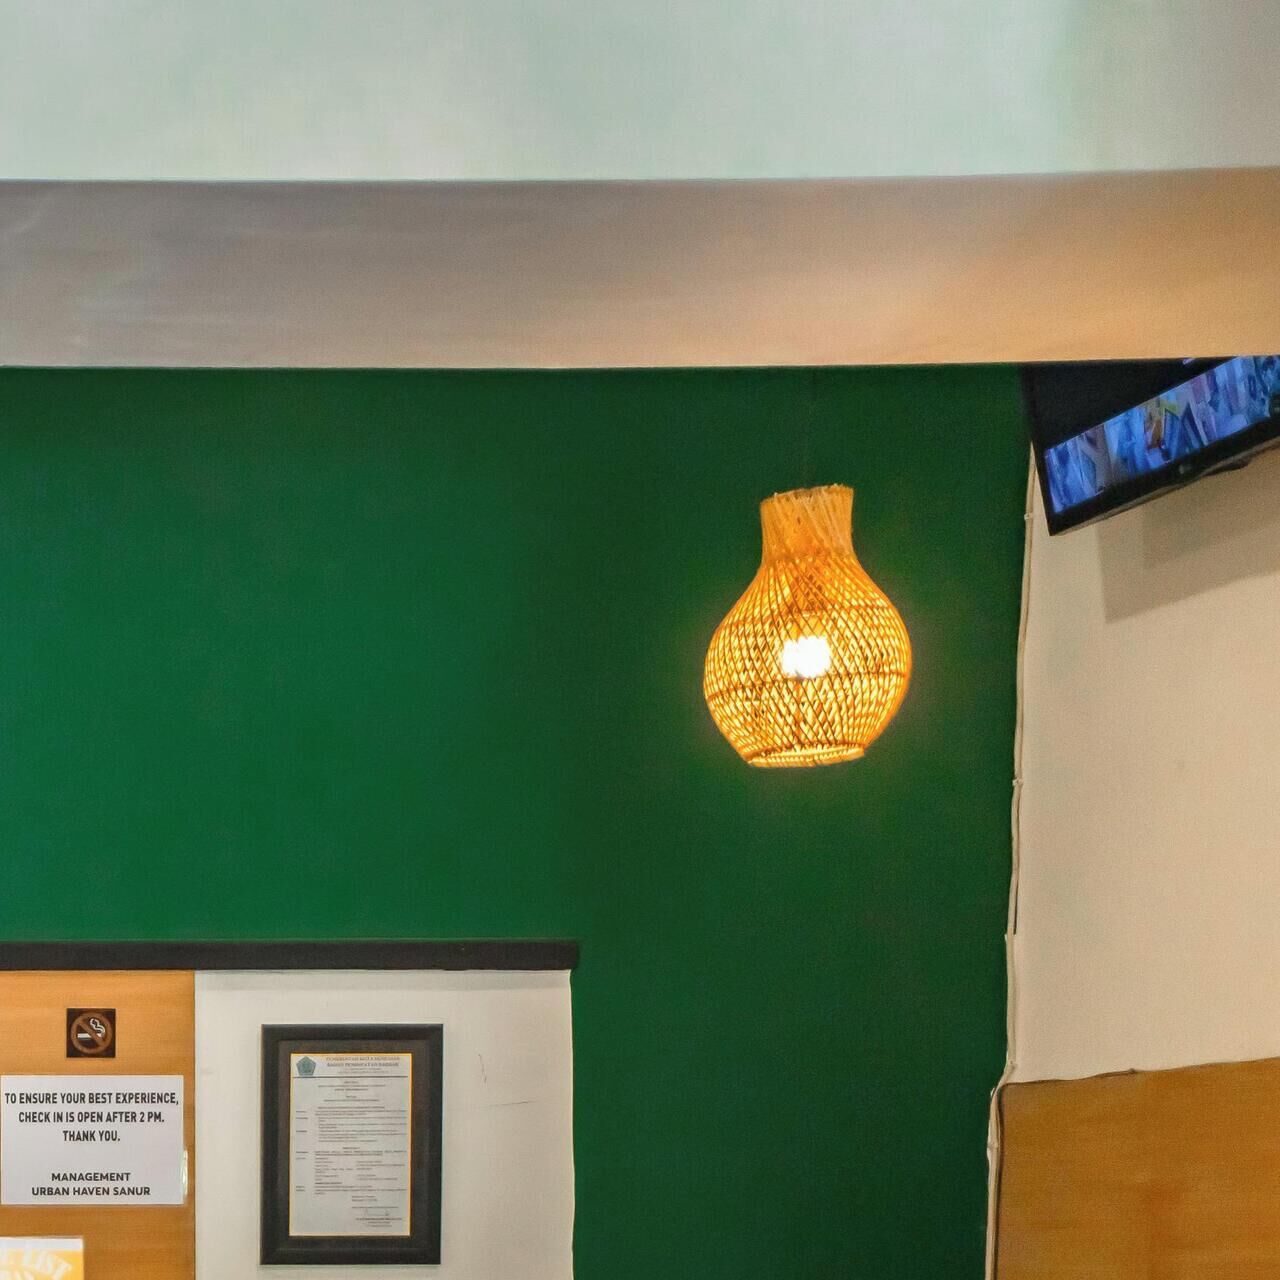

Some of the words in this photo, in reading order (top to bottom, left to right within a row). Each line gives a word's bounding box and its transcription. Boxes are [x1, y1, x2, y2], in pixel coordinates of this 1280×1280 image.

[5, 1093, 16, 1104] TO
[19, 1093, 57, 1104] ENSURE
[60, 1093, 85, 1104] YOUR
[88, 1092, 112, 1104] BEST
[115, 1092, 179, 1105] EXPERIENCE,
[18, 1112, 51, 1123] CHECK
[53, 1112, 63, 1123] IN
[65, 1112, 75, 1123] IS
[77, 1112, 103, 1123] OPEN
[105, 1112, 137, 1122] AFTER
[139, 1112, 145, 1122] 2
[147, 1112, 165, 1123] PM.
[63, 1130, 96, 1141] THANK
[98, 1130, 121, 1141] YOU.
[51, 1173, 131, 1182] MANAGEMENT
[31, 1187, 70, 1196] URBAN
[72, 1187, 110, 1196] HAVEN
[113, 1187, 151, 1196] SANUR
